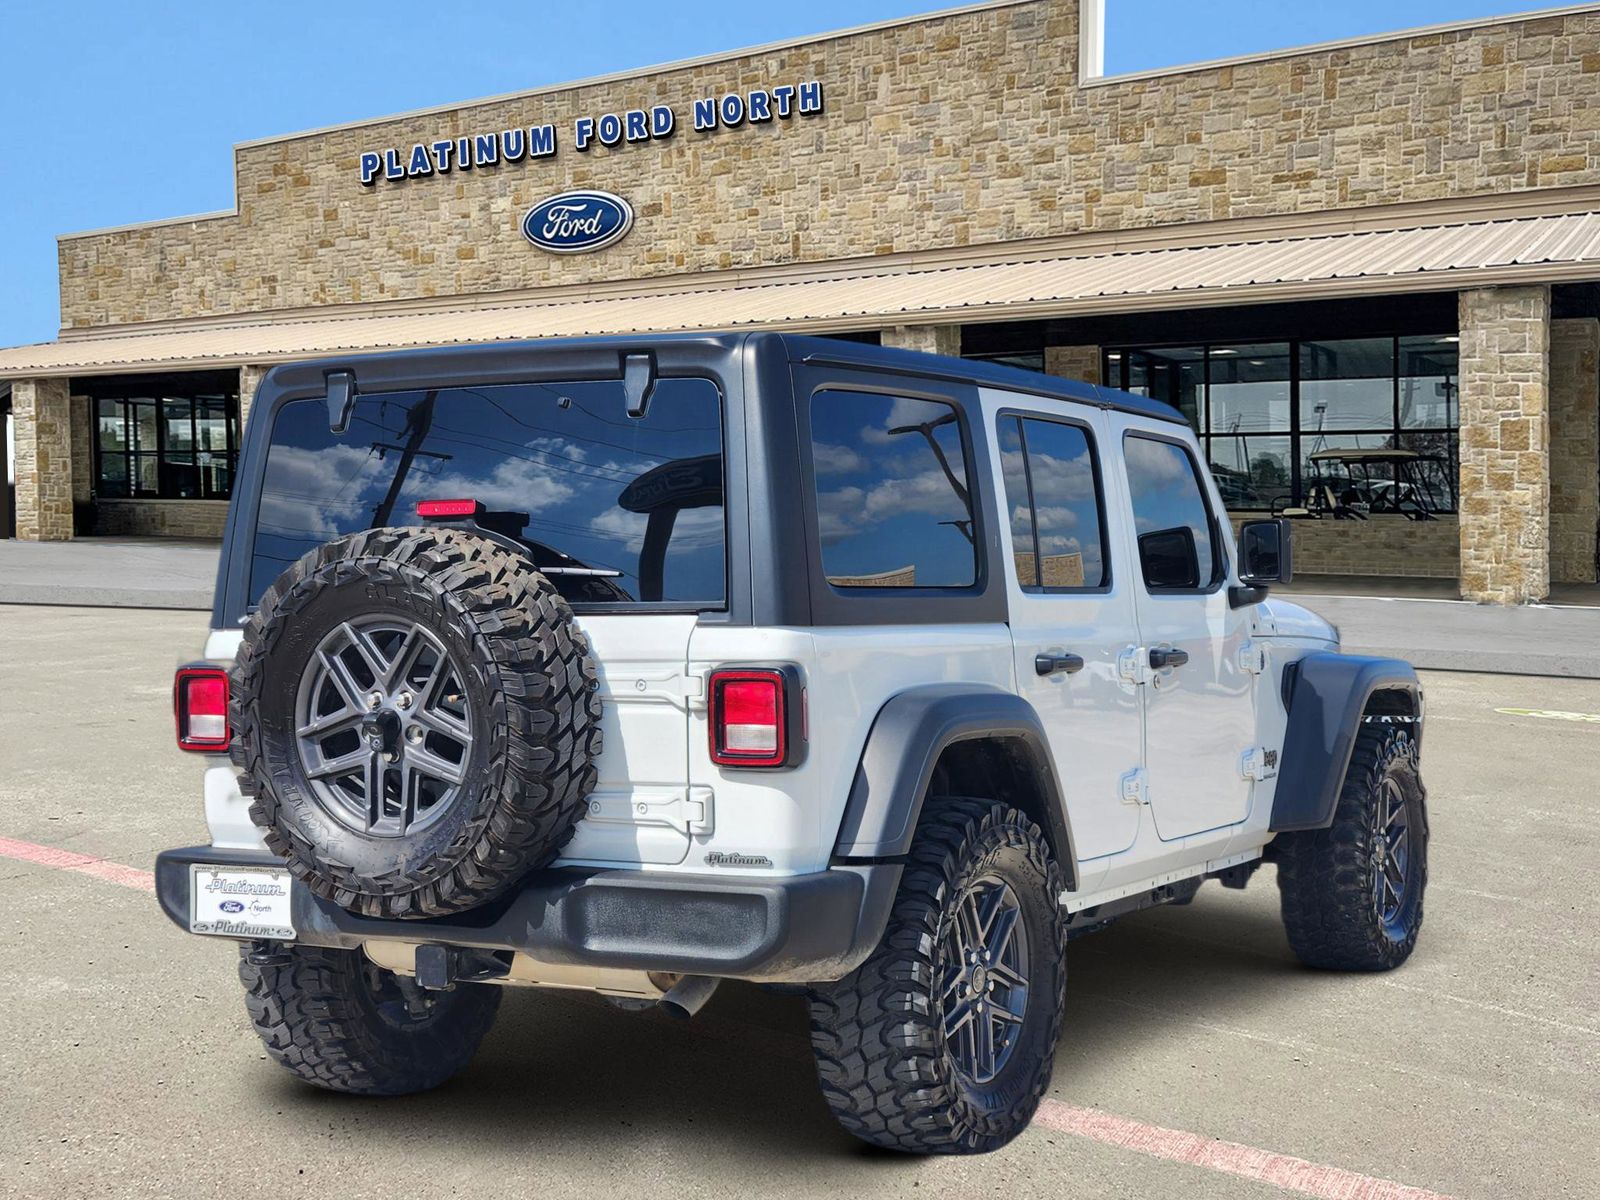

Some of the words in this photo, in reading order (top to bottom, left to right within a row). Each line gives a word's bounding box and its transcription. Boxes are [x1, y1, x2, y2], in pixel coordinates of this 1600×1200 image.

[360, 124, 556, 185] PLATINUM
[575, 105, 675, 154] FORD
[693, 80, 824, 132] NORTH
[541, 203, 603, 241] Ford
[704, 852, 774, 869] Platinum
[205, 879, 286, 896] Platinum
[222, 901, 242, 912] Ford
[214, 920, 275, 936] Platinum
